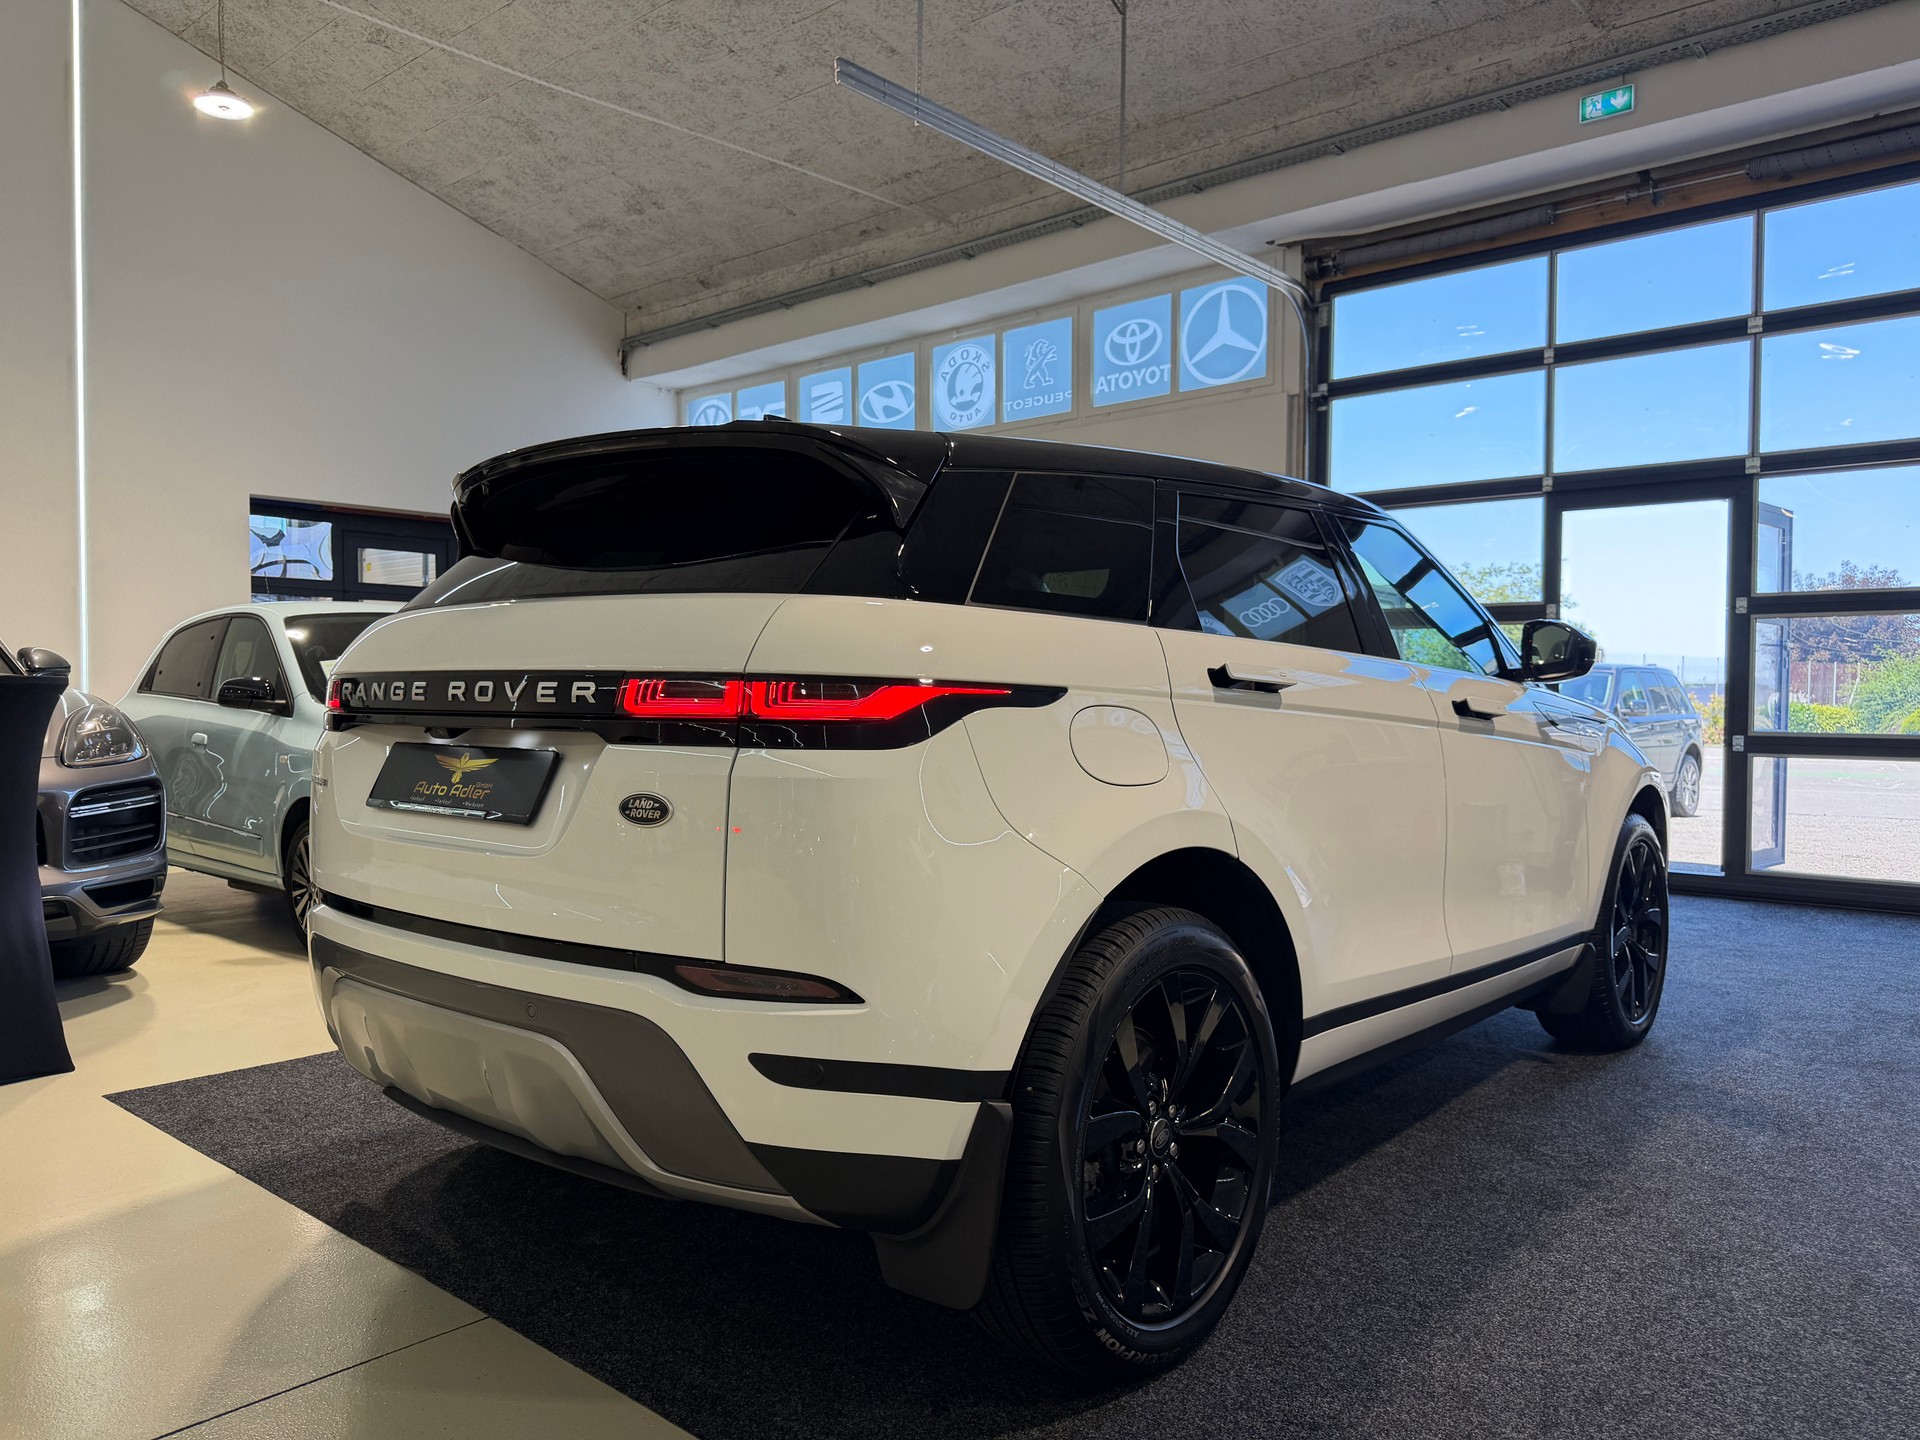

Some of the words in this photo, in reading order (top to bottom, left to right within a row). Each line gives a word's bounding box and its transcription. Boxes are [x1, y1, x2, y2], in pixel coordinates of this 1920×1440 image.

[342, 681, 428, 701] RANGE
[447, 680, 598, 703] ROVER
[413, 781, 447, 795] Auto
[449, 784, 490, 800] Adler
[628, 799, 654, 809] LAND
[630, 809, 661, 819] ROVER
